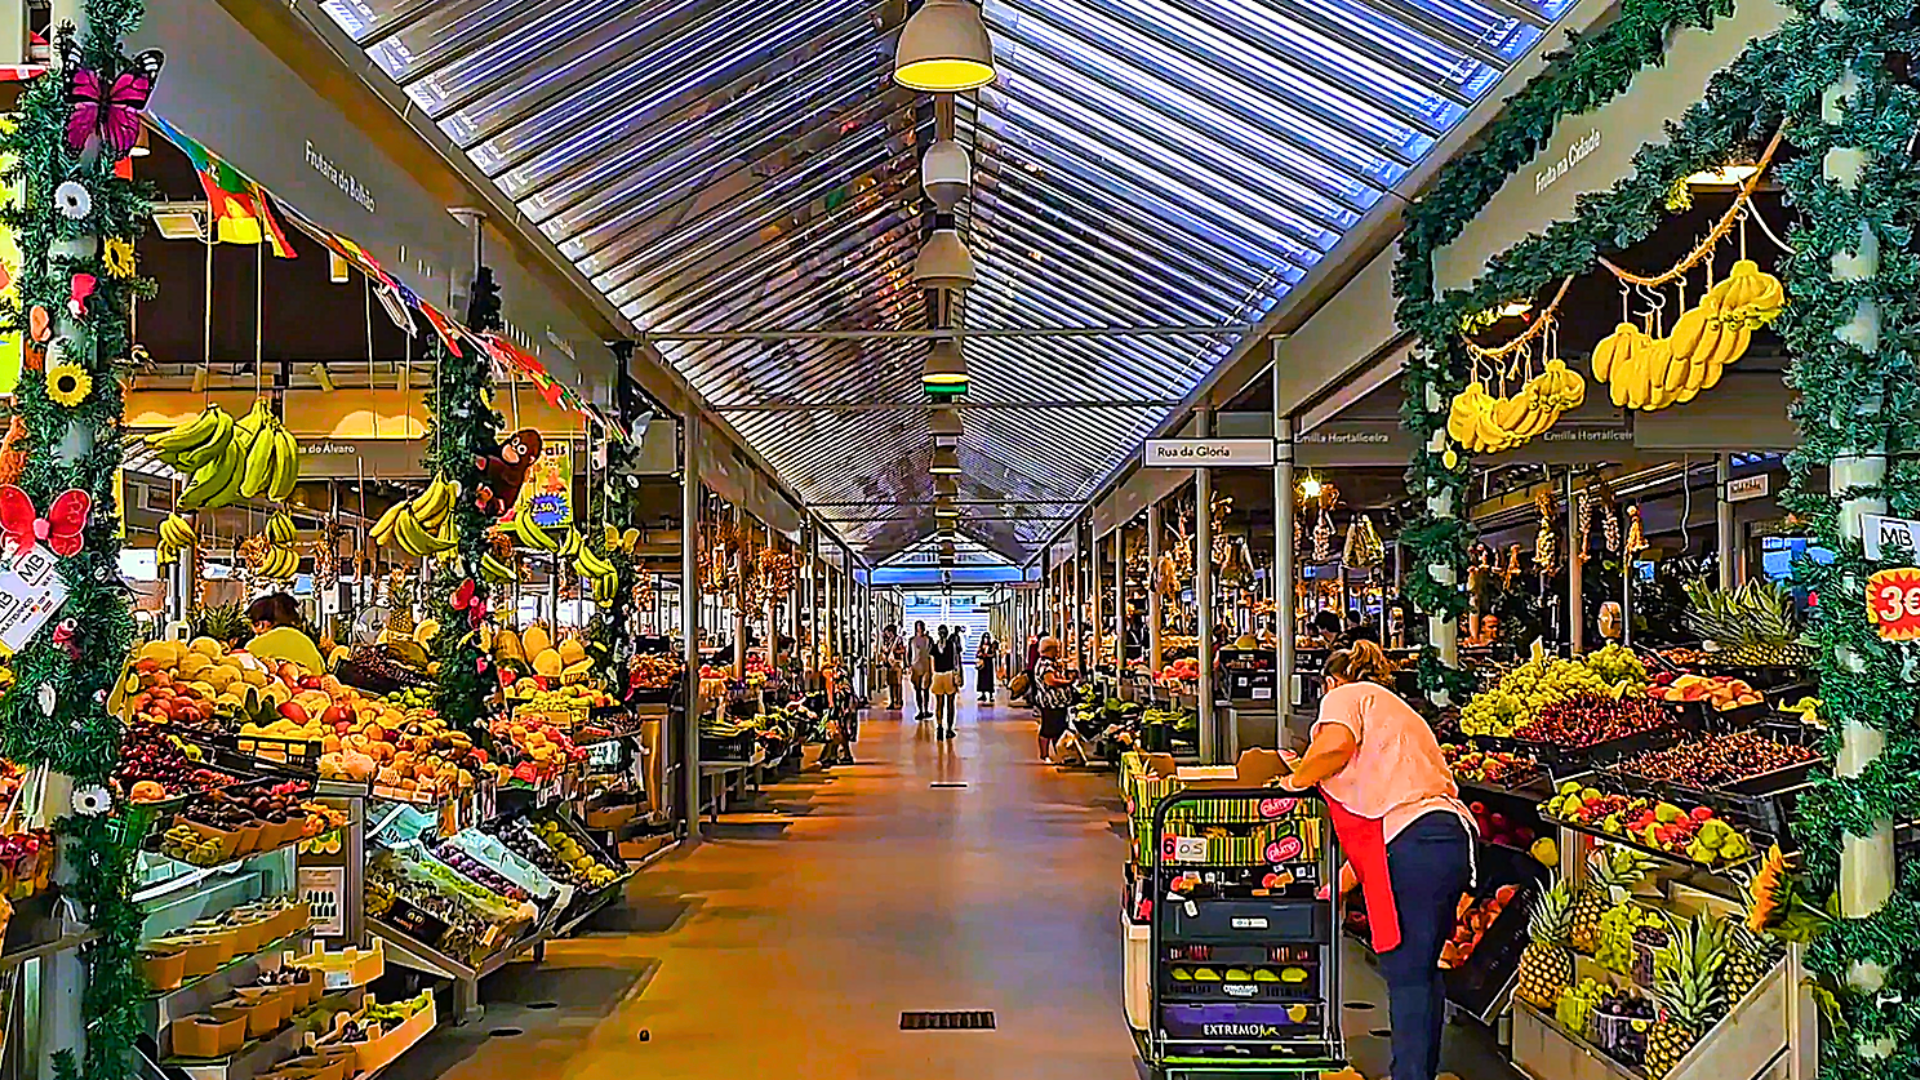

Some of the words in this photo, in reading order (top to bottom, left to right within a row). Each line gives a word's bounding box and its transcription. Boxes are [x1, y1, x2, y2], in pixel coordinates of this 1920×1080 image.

[1556, 156, 1569, 178] na
[1568, 127, 1601, 168] Cidade
[1577, 429, 1633, 441] Hortaliceir
[308, 443, 322, 454] do
[323, 440, 356, 454] Álvaro
[1157, 446, 1178, 457] Rua
[1179, 446, 1194, 457] da
[1880, 526, 1913, 547] MB
[18, 554, 45, 583] MB
[1163, 837, 1175, 855] 6
[1269, 841, 1298, 862] plump
